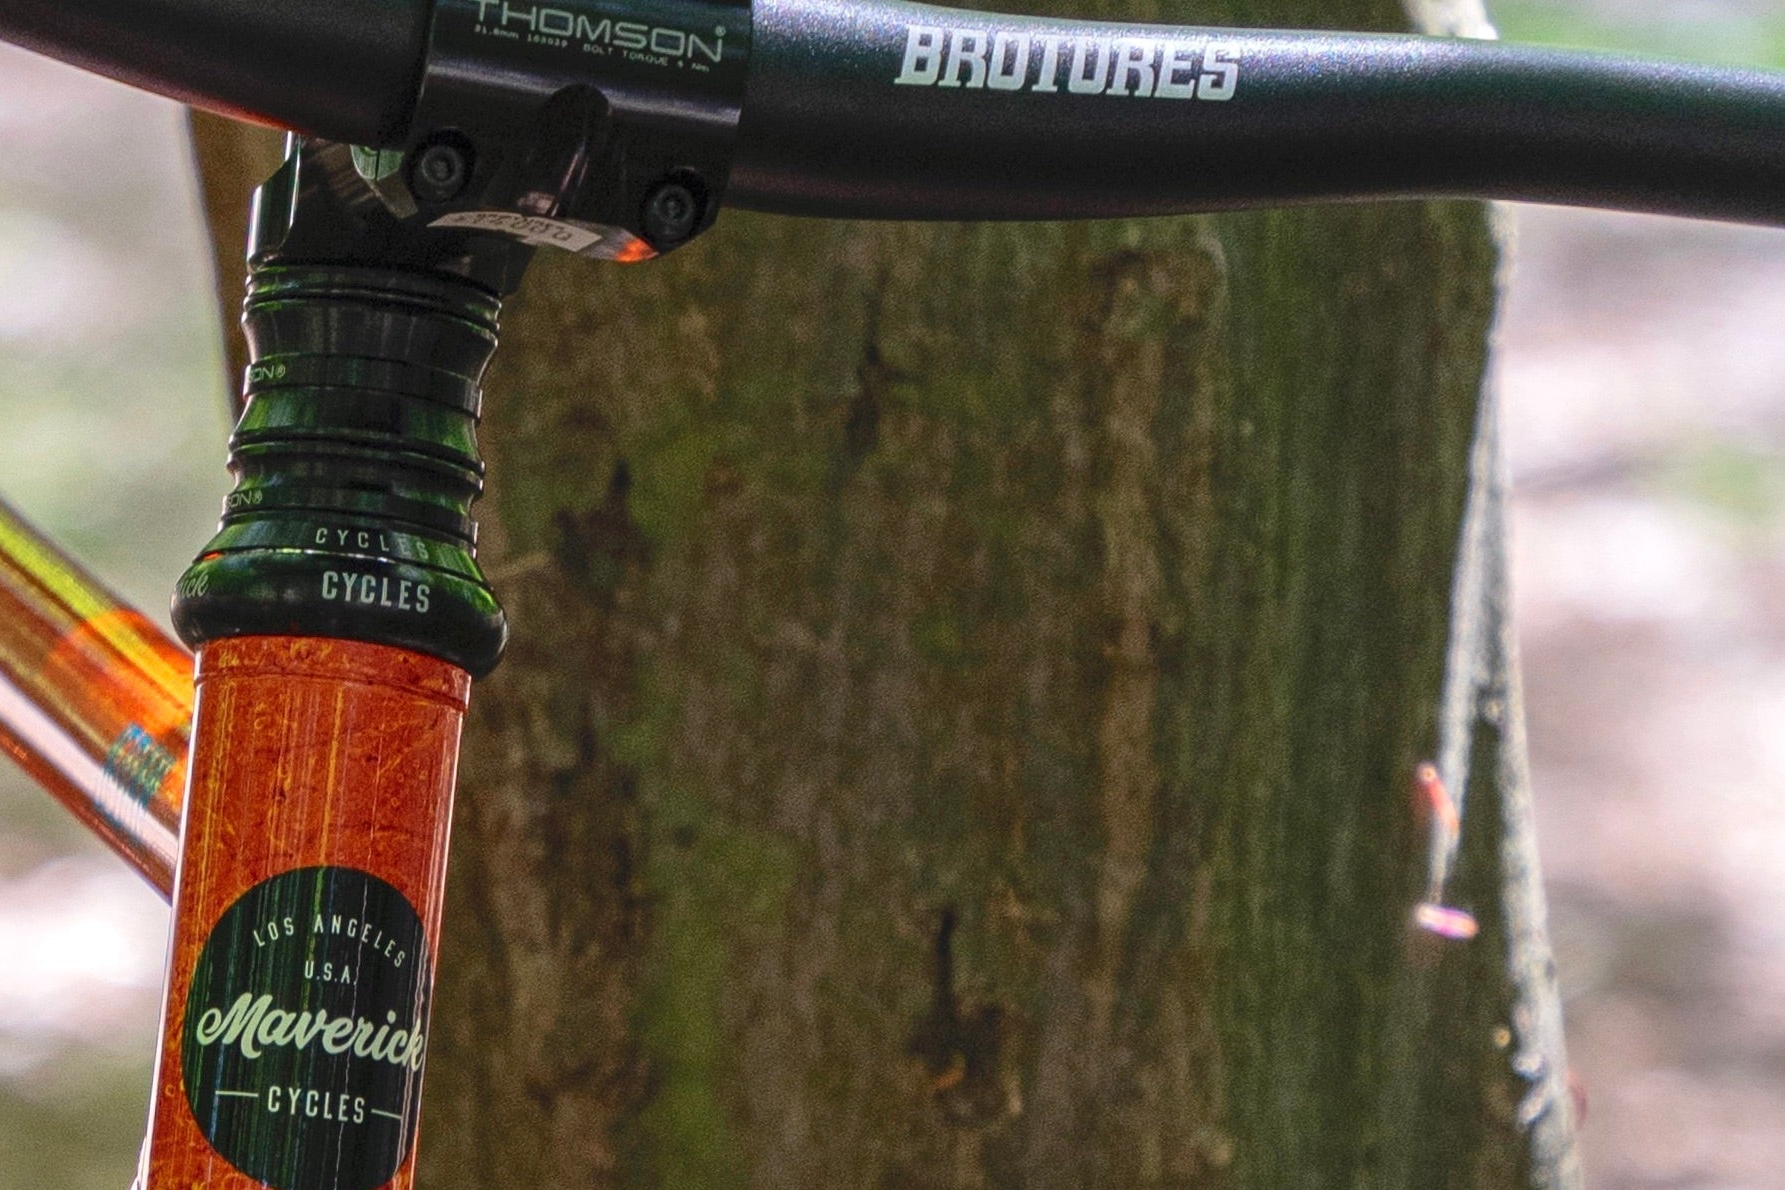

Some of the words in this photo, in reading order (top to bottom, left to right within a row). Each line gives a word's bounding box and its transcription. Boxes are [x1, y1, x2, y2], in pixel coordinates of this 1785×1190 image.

[473, 0, 723, 63] THOMSON
[893, 25, 1240, 101] BROTURES
[315, 527, 430, 559] CYCLES
[322, 570, 431, 614] CYCLES
[253, 917, 294, 947] LOS
[314, 914, 405, 968] ANGELES
[196, 992, 425, 1073] Maverick
[267, 1085, 365, 1124] CYCLES
